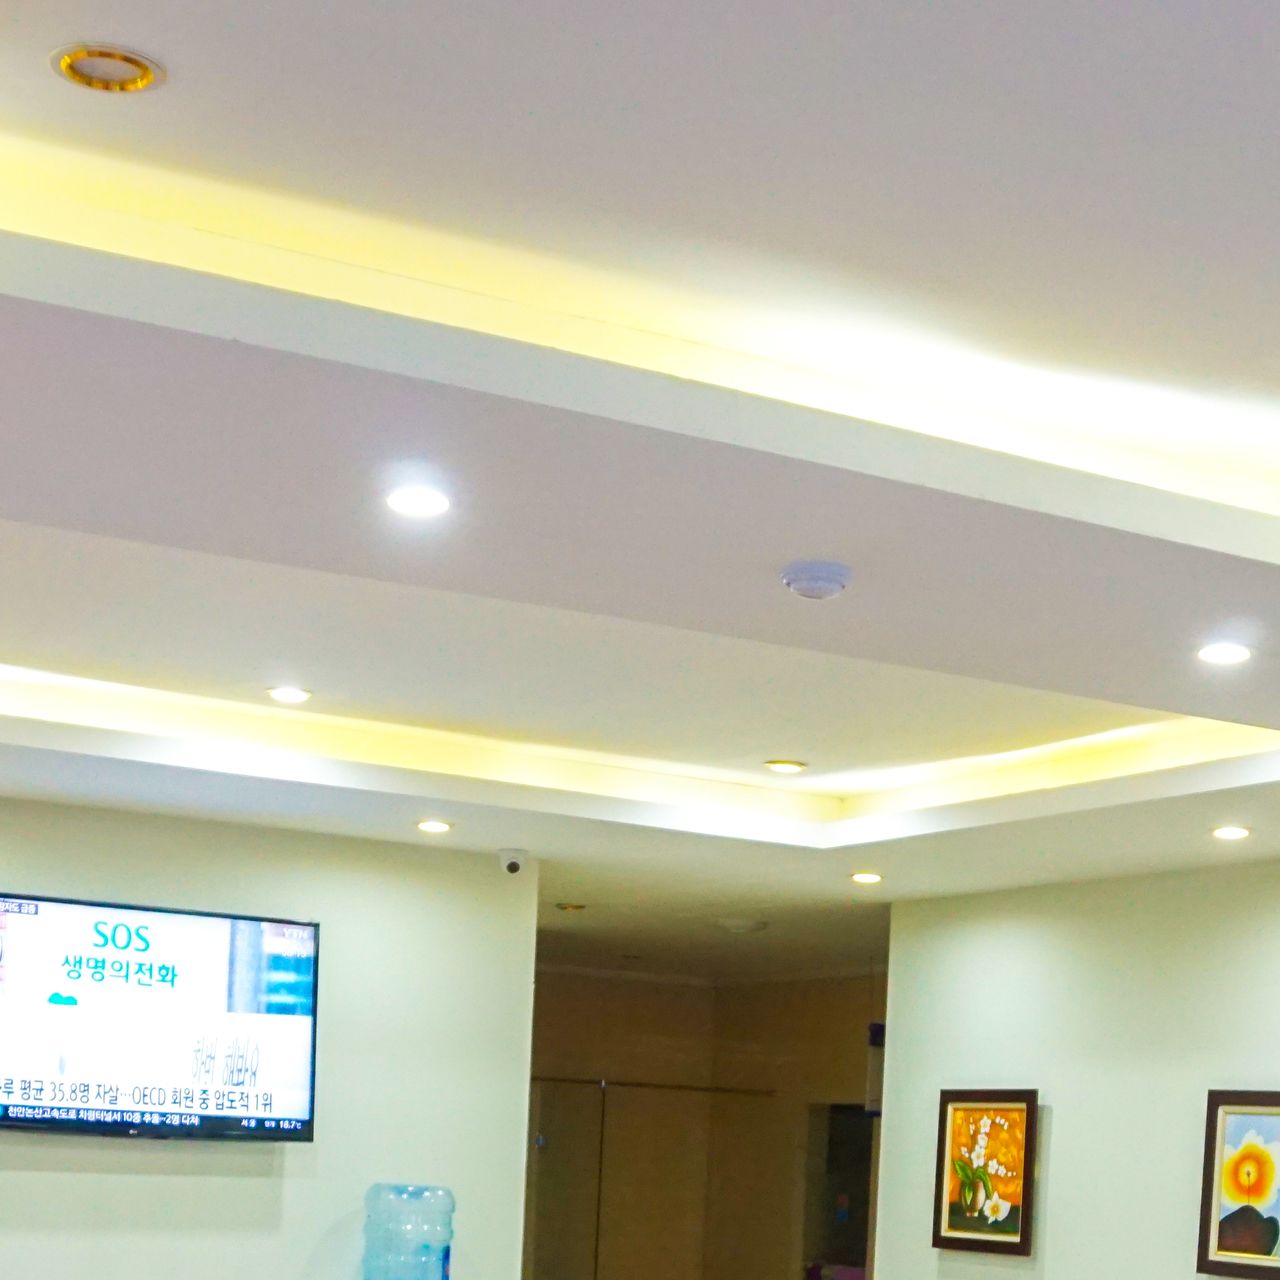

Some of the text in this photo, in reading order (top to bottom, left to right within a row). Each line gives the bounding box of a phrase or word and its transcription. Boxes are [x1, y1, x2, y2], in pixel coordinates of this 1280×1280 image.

[92, 921, 150, 952] SOS
[62, 955, 178, 988] 생명의전화
[19, 1079, 45, 1101] 평균
[49, 1081, 91, 1104] 35.8명
[170, 1087, 194, 1109] 회원
[198, 1089, 211, 1110] 중
[214, 1089, 250, 1112] 압도적
